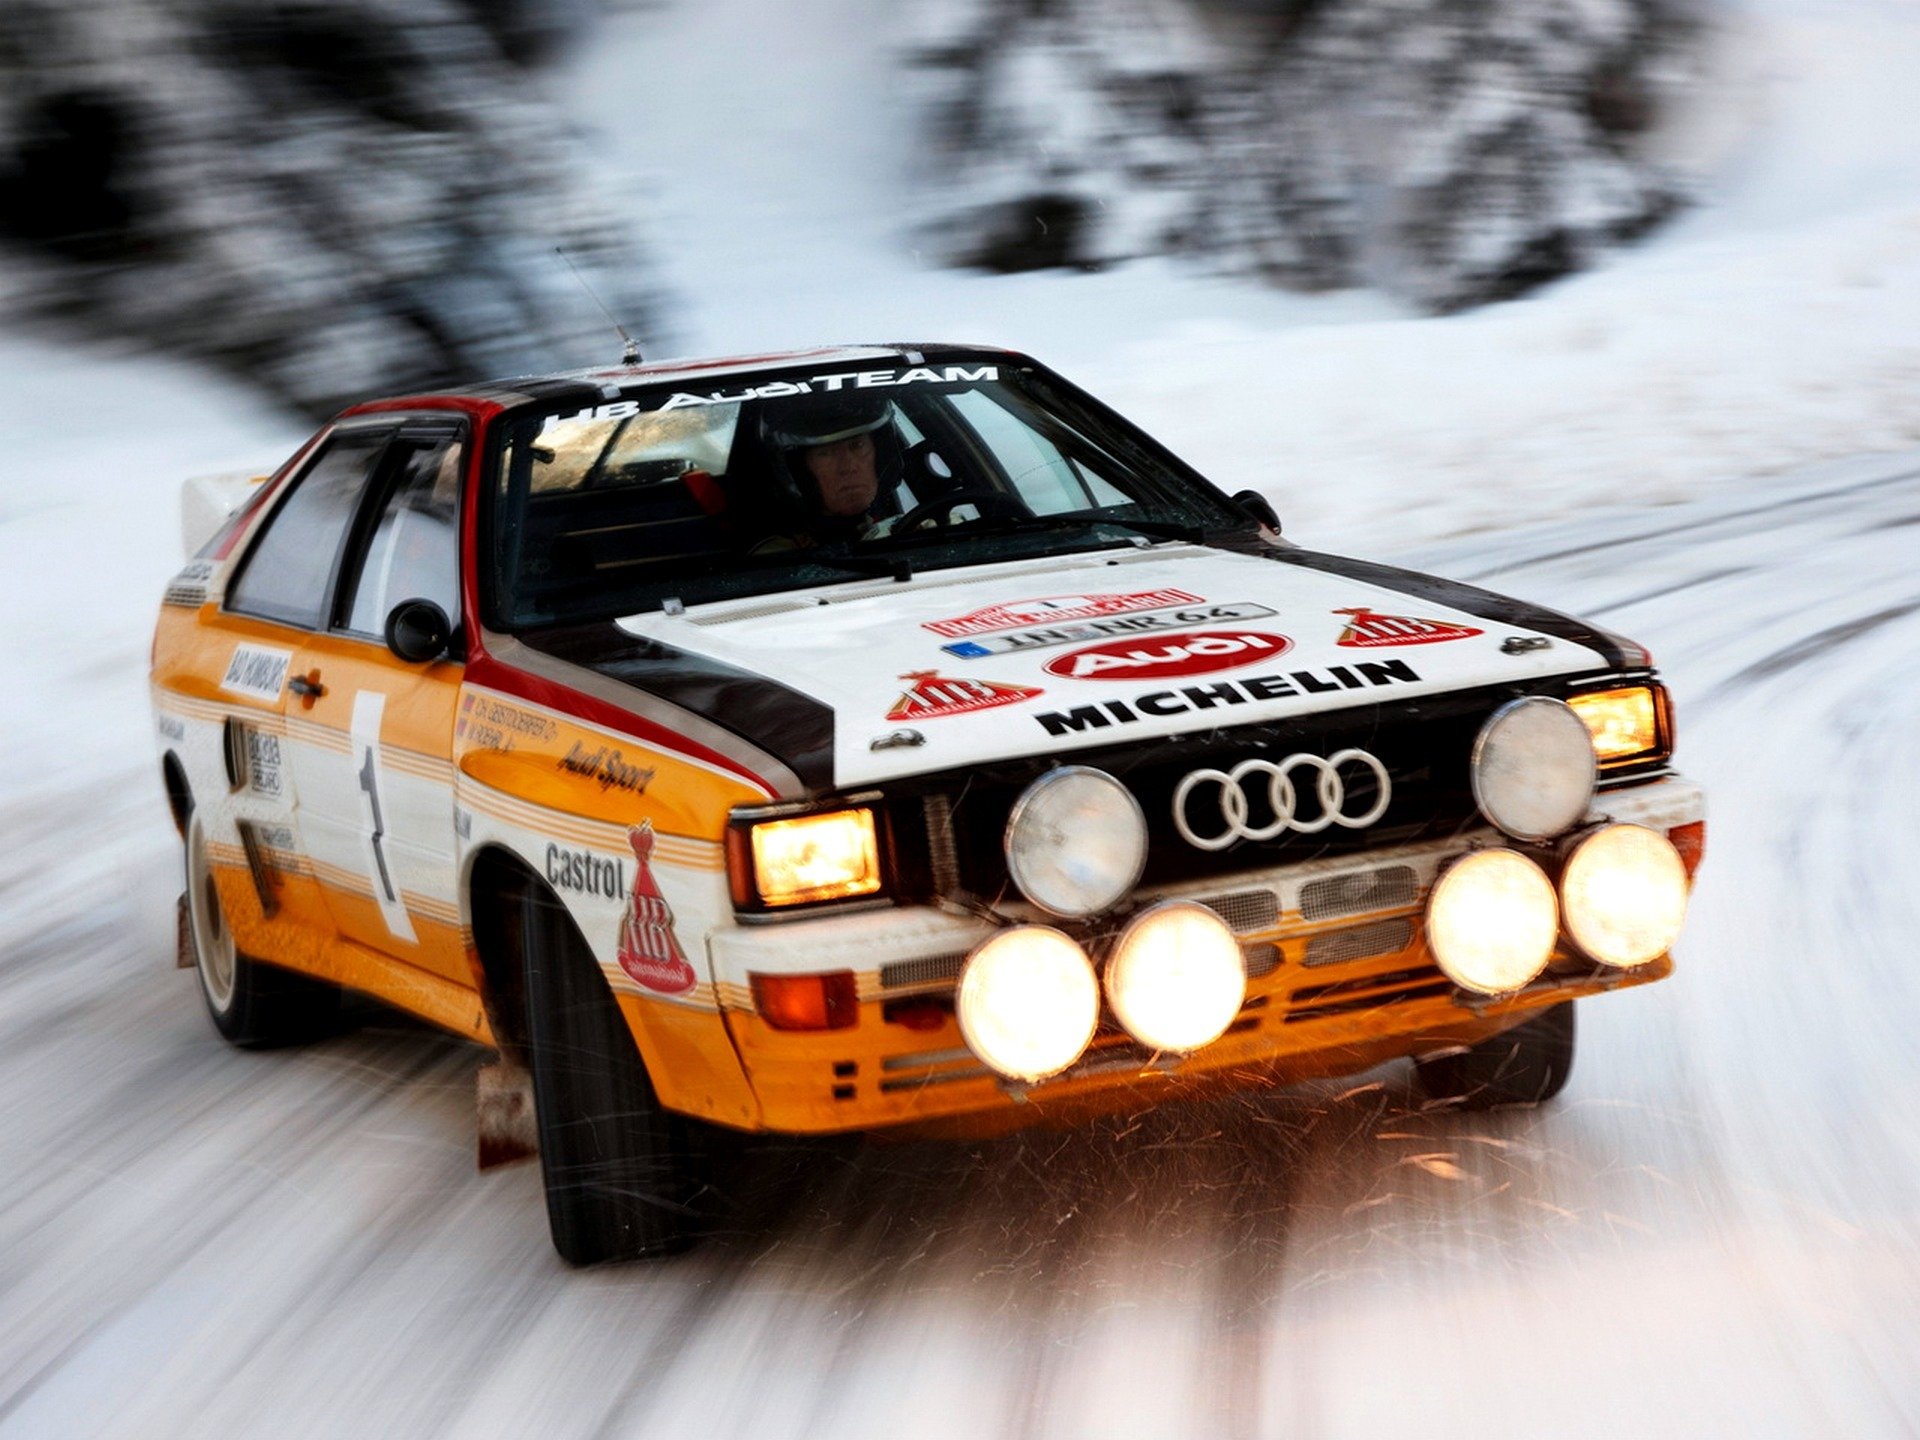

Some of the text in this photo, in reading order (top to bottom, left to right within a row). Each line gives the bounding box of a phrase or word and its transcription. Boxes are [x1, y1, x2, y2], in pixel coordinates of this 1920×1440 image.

[542, 401, 640, 433] HB
[812, 366, 1000, 391] TEAM
[1090, 616, 1172, 634] NR
[1175, 608, 1240, 623] 64
[1034, 659, 1423, 737] MICHELIN
[556, 739, 656, 795] Audi Sport
[359, 745, 397, 903] 1
[546, 841, 624, 900] Castrol
